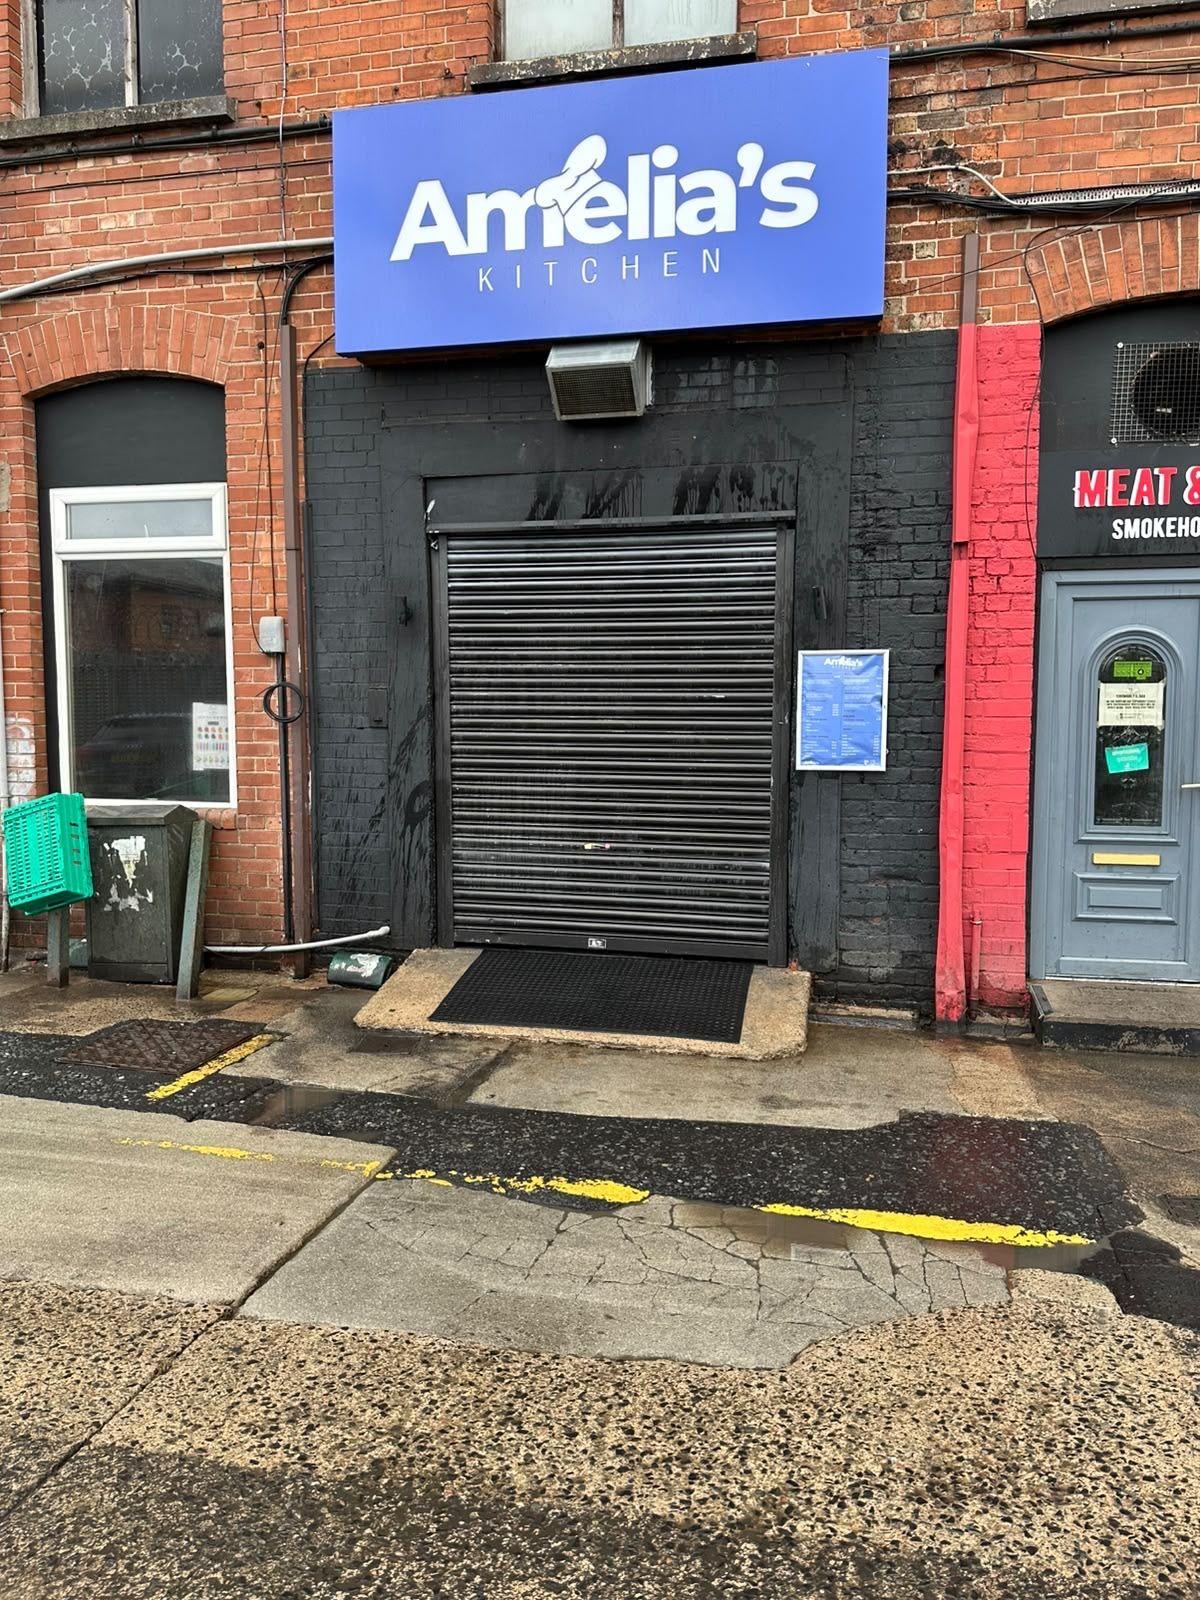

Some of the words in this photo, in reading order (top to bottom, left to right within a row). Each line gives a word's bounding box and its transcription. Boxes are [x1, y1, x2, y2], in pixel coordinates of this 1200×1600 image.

[389, 142, 819, 262] Amelia's
[477, 247, 722, 293] KITCHEN
[1073, 467, 1178, 508] MEAT
